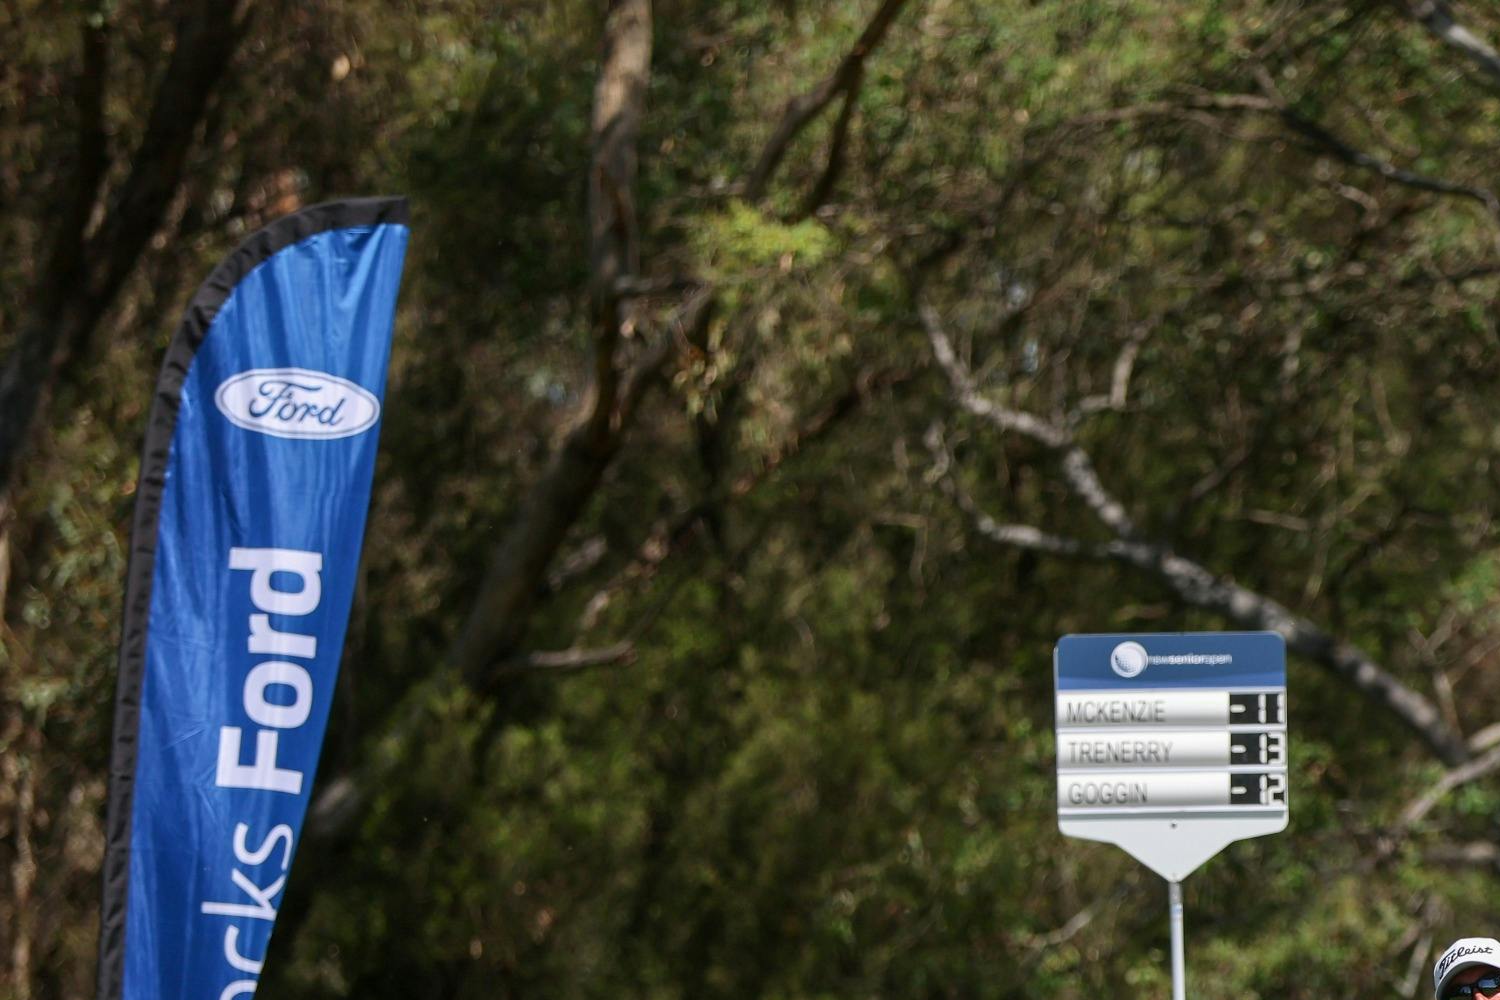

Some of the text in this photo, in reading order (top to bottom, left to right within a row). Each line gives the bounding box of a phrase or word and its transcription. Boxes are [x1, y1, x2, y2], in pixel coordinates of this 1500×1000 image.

[248, 380, 346, 426] Ford
[214, 546, 323, 795] Ford
[1066, 700, 1168, 724] MCKENZIE
[1067, 741, 1174, 764] TRENERRY
[1067, 782, 1149, 805] GOGGIN
[1439, 945, 1494, 980] Titleist
